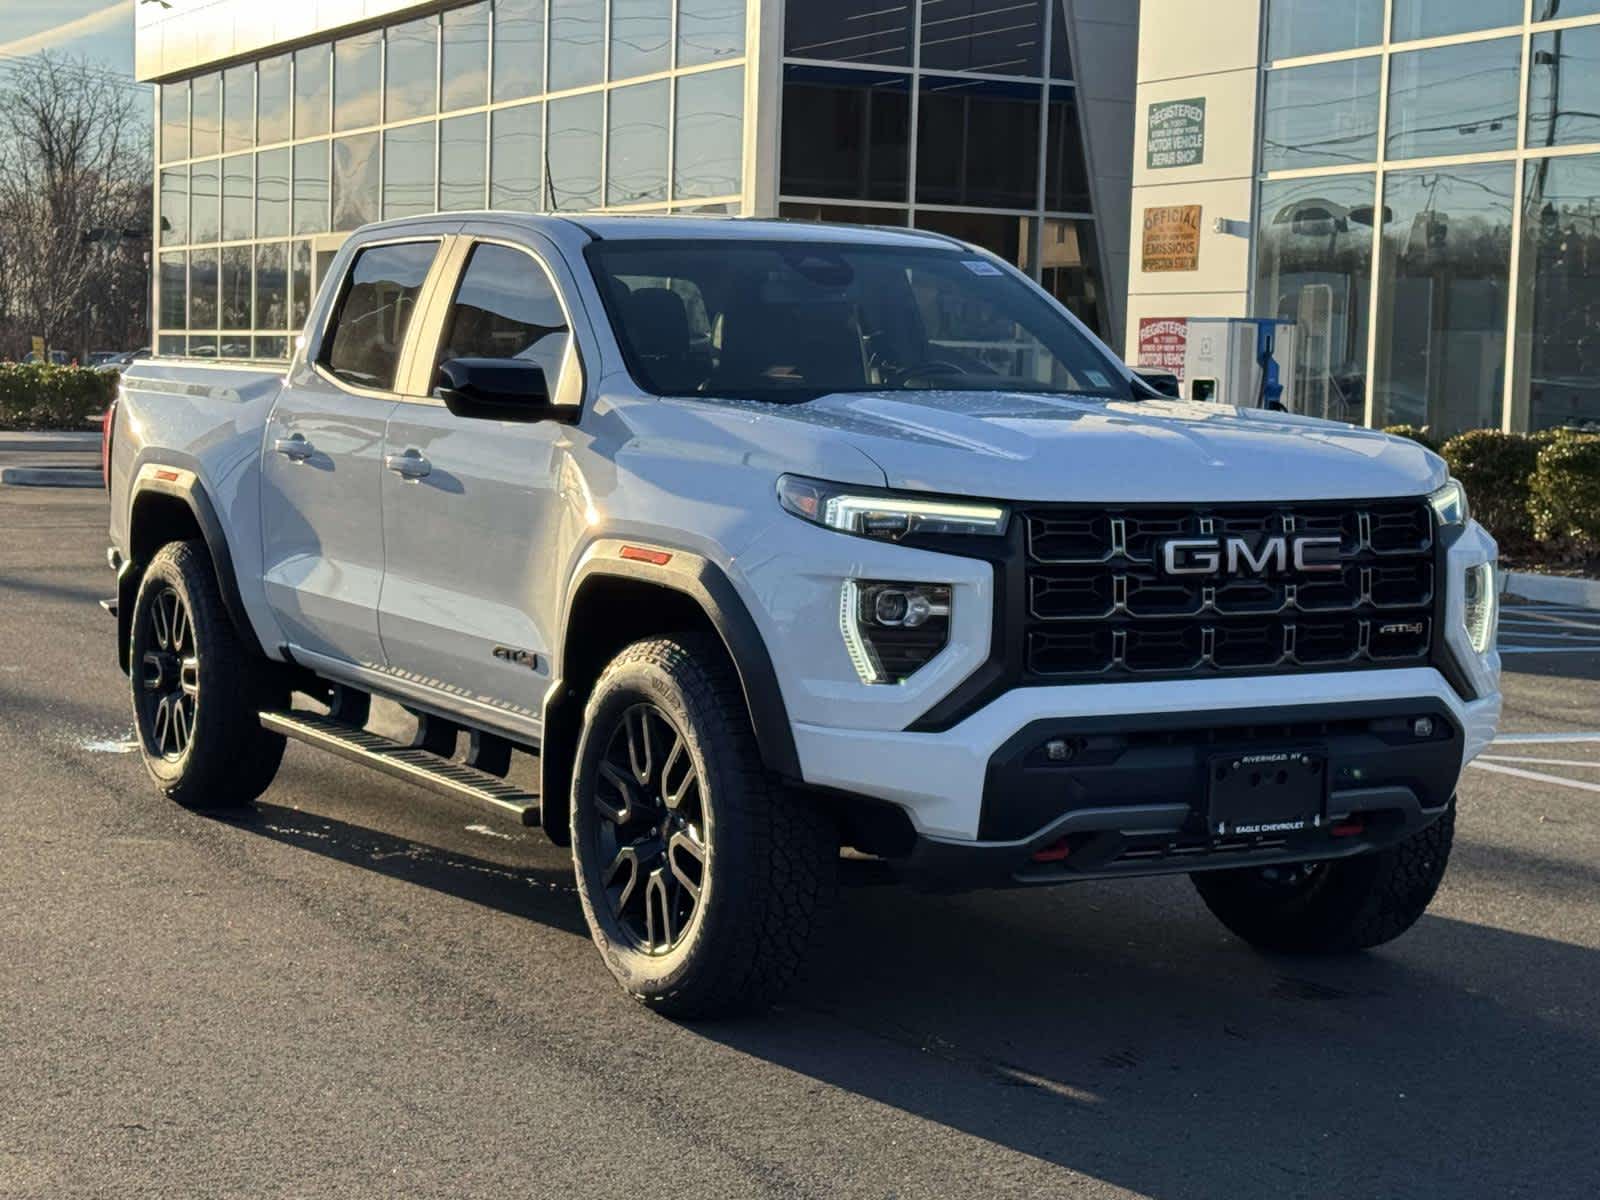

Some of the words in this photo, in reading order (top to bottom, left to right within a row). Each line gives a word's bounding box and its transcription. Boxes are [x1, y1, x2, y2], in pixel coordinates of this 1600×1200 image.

[1150, 104, 1203, 124] REGISTERED
[1149, 138, 1172, 152] MOTOR
[1173, 134, 1202, 149] VEHICLE
[1152, 152, 1175, 166] REPAIR
[1176, 149, 1196, 164] SHOP
[1144, 209, 1197, 230] OFFICIAL
[1144, 241, 1195, 256] EMISSIONS
[1141, 321, 1188, 341] REGISTERE
[1139, 352, 1162, 366] MOTOR
[1163, 352, 1184, 365] VEHIC
[1164, 537, 1342, 575] GMC
[1235, 824, 1260, 834] EAGLE
[1261, 821, 1304, 831] CHEVROLET
